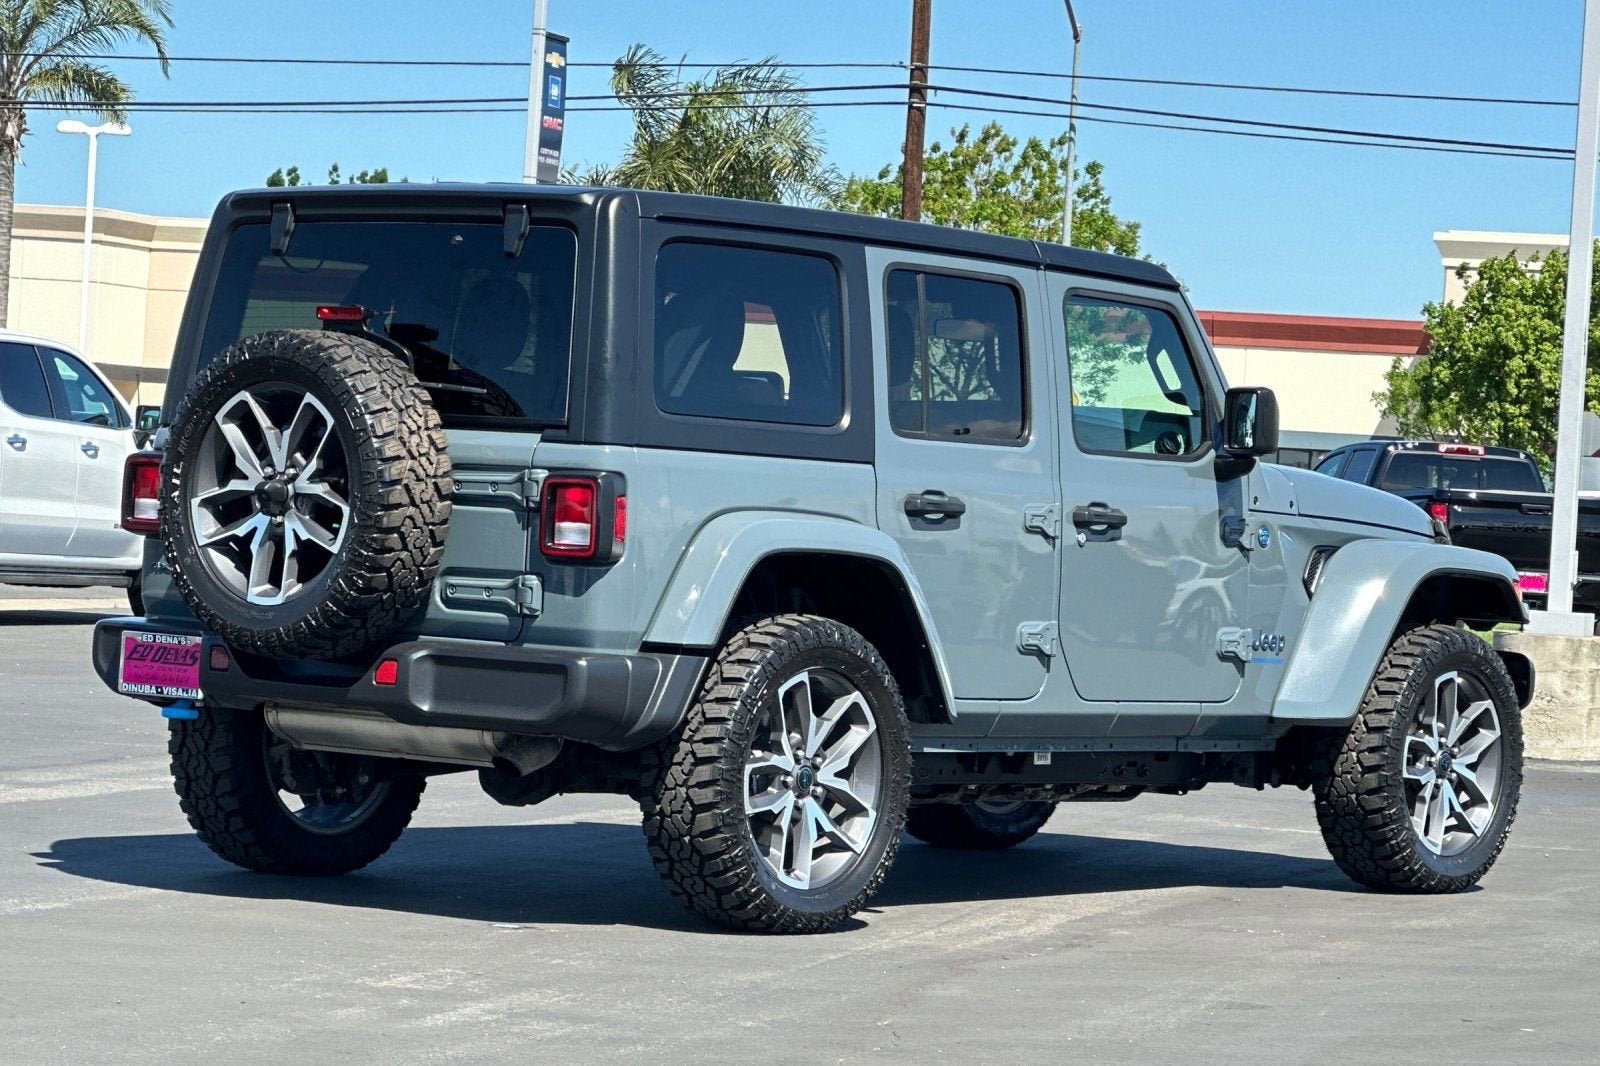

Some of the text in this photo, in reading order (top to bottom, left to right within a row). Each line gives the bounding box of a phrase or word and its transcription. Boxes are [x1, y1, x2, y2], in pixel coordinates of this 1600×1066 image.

[543, 115, 563, 131] GMC
[142, 634, 186, 645] ED DENA'S
[1251, 629, 1286, 657] Jeep
[127, 643, 154, 662] ED
[122, 684, 197, 697] DINUBA VISALIA
